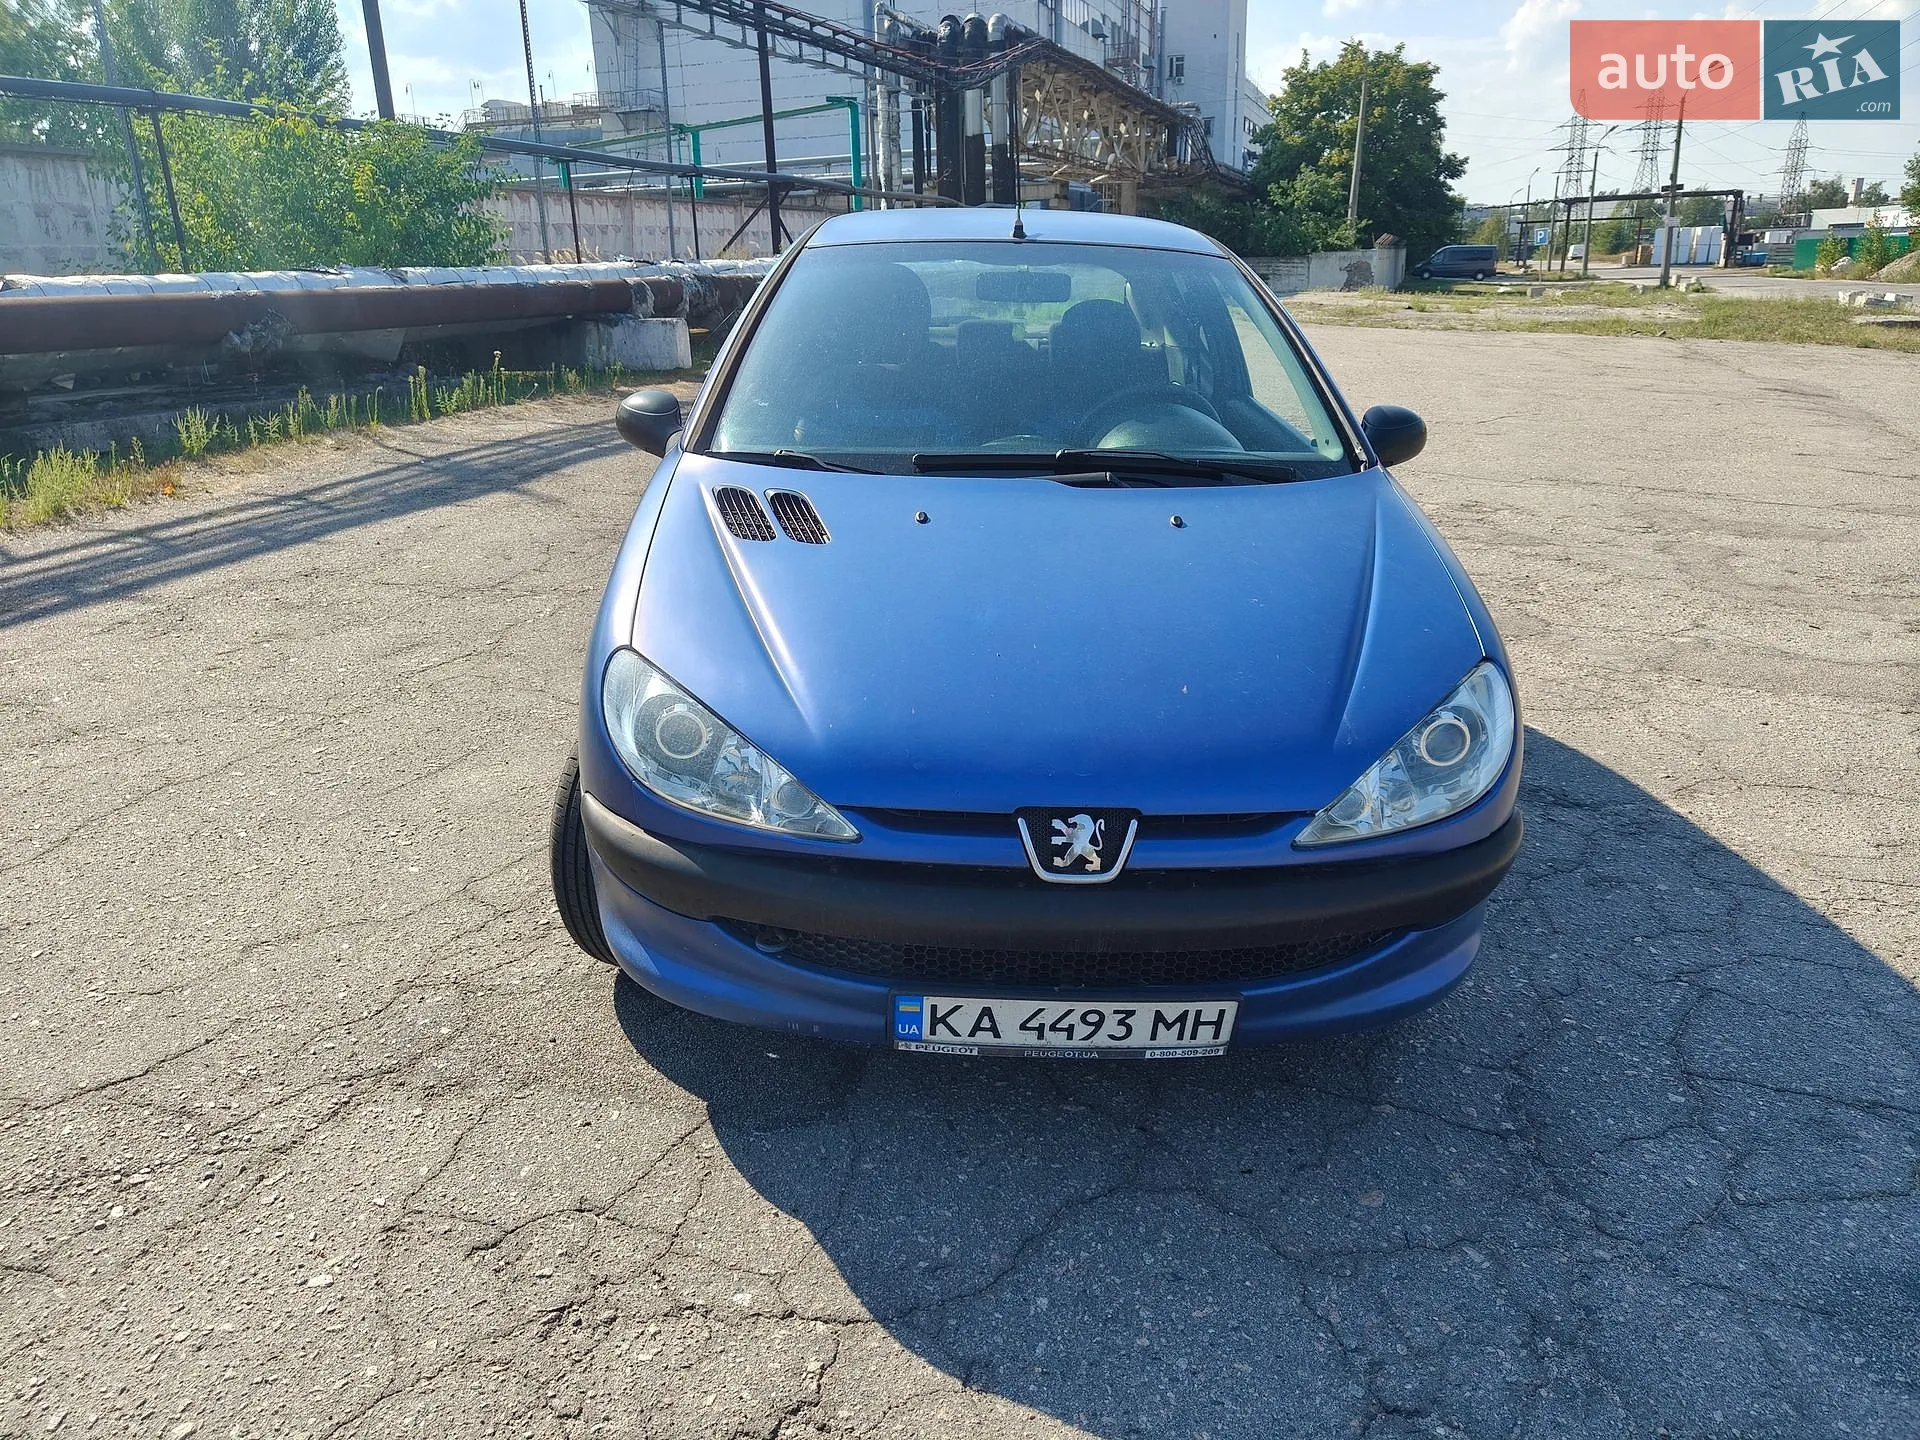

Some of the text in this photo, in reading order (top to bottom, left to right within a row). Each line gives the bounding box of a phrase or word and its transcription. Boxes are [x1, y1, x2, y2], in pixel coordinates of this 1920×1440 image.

[1537, 230, 1545, 243] P
[929, 1004, 1227, 1041] KA 4493 MH
[898, 1024, 919, 1035] UA
[915, 1043, 974, 1055] PEUGEOT
